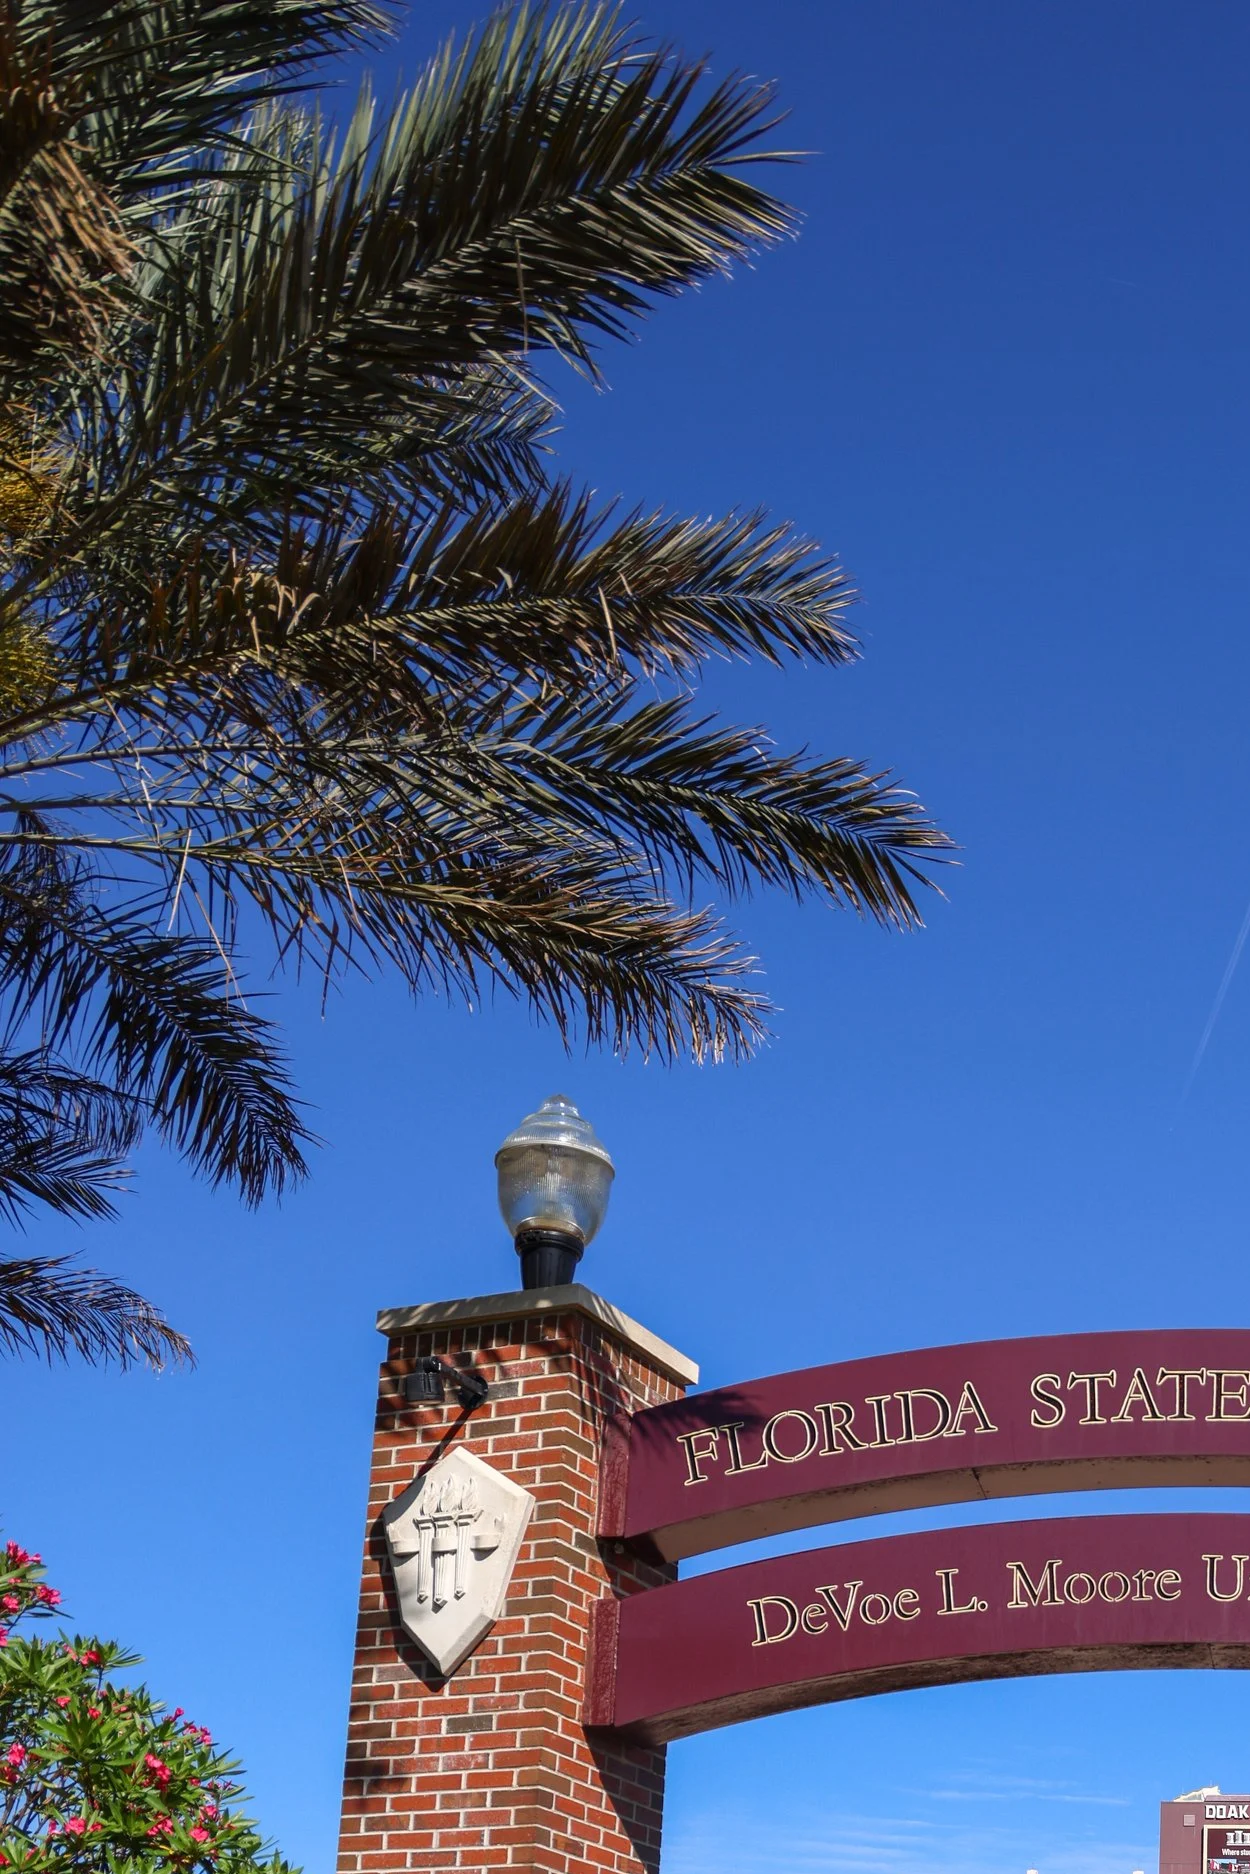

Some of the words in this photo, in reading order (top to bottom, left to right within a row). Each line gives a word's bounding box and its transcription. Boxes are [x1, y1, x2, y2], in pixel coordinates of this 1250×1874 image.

[676, 1381, 997, 1486] FLORIDA
[746, 1580, 920, 1647] DeVoe
[936, 1568, 988, 1616] L.
[1006, 1559, 1183, 1610] Moore
[1205, 1805, 1250, 1820] DOAK
[1221, 1848, 1240, 1856] Where
